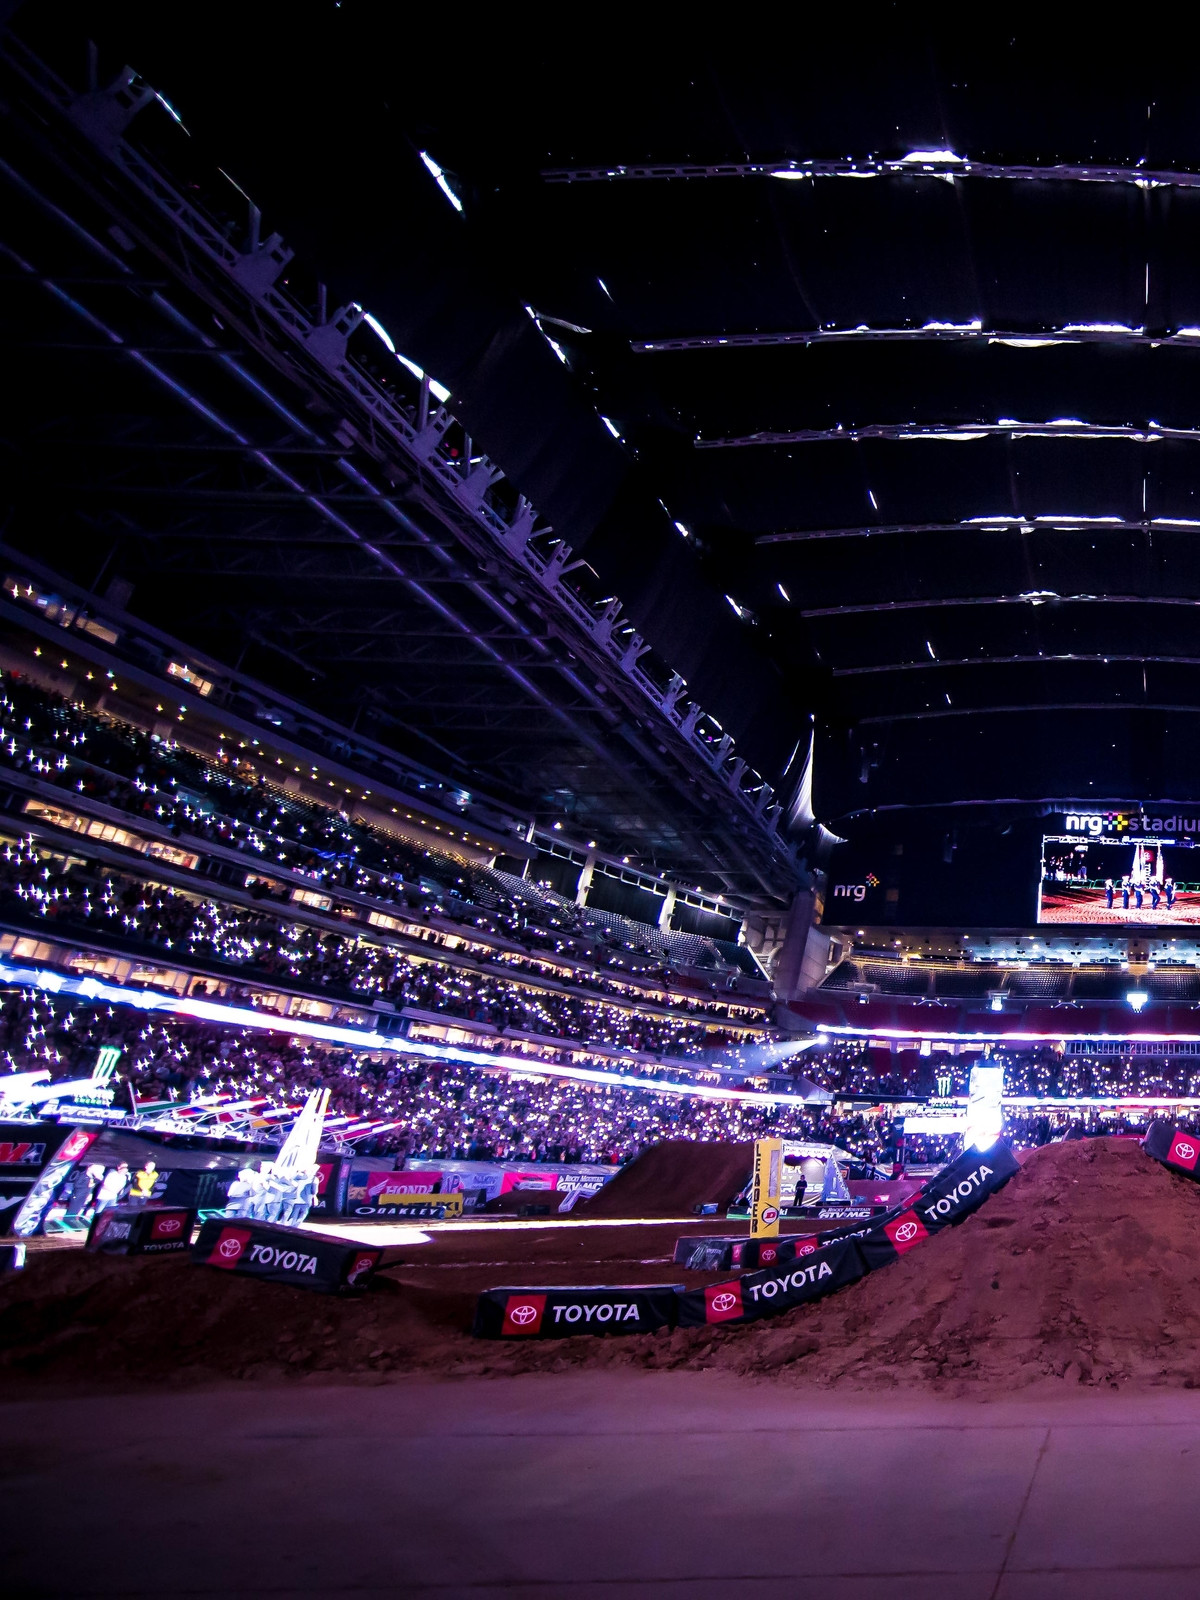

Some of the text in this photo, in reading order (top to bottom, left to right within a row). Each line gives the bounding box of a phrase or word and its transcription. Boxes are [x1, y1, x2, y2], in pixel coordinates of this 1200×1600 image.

[1065, 814, 1102, 836] nrg
[833, 884, 866, 902] nrg
[752, 1143, 762, 1233] LEADER
[924, 1165, 994, 1220] TOYOTA
[377, 1207, 438, 1215] OAKLEY
[143, 1241, 185, 1251] TOYOTA
[249, 1244, 318, 1275] TOYOTA
[749, 1262, 833, 1301] TOYOTA
[552, 1304, 640, 1322] TOYOTA
